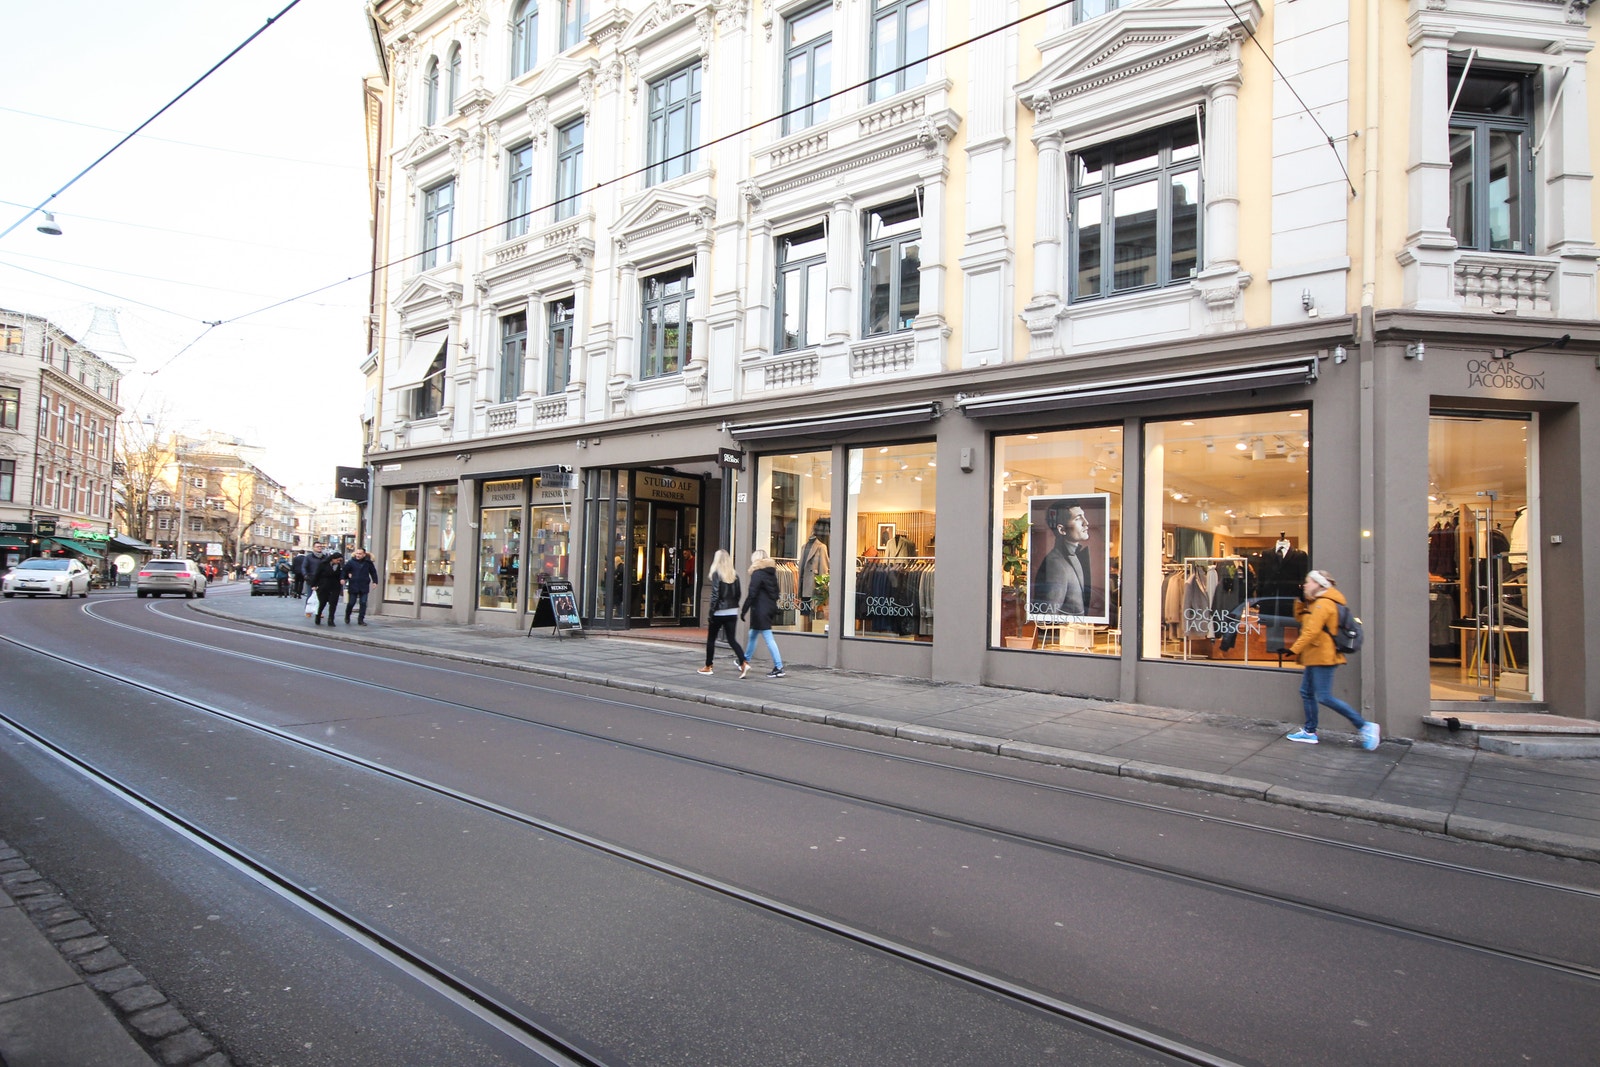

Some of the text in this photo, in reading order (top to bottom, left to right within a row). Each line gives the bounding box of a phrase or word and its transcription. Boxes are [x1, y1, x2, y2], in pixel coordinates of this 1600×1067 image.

[1467, 359, 1545, 376] OSCAR
[1467, 373, 1545, 390] JACOBSON
[486, 482, 510, 493] STUDIO
[510, 481, 522, 491] ALF
[643, 476, 692, 491] STUDIO ALF
[866, 596, 914, 608] OSCAR
[1024, 602, 1085, 615] OSCAR
[866, 605, 914, 617] JACOBSON
[1183, 608, 1261, 623] OSCAR
[1024, 613, 1085, 625] JACOBSON
[1185, 620, 1261, 636] JACOBSON
